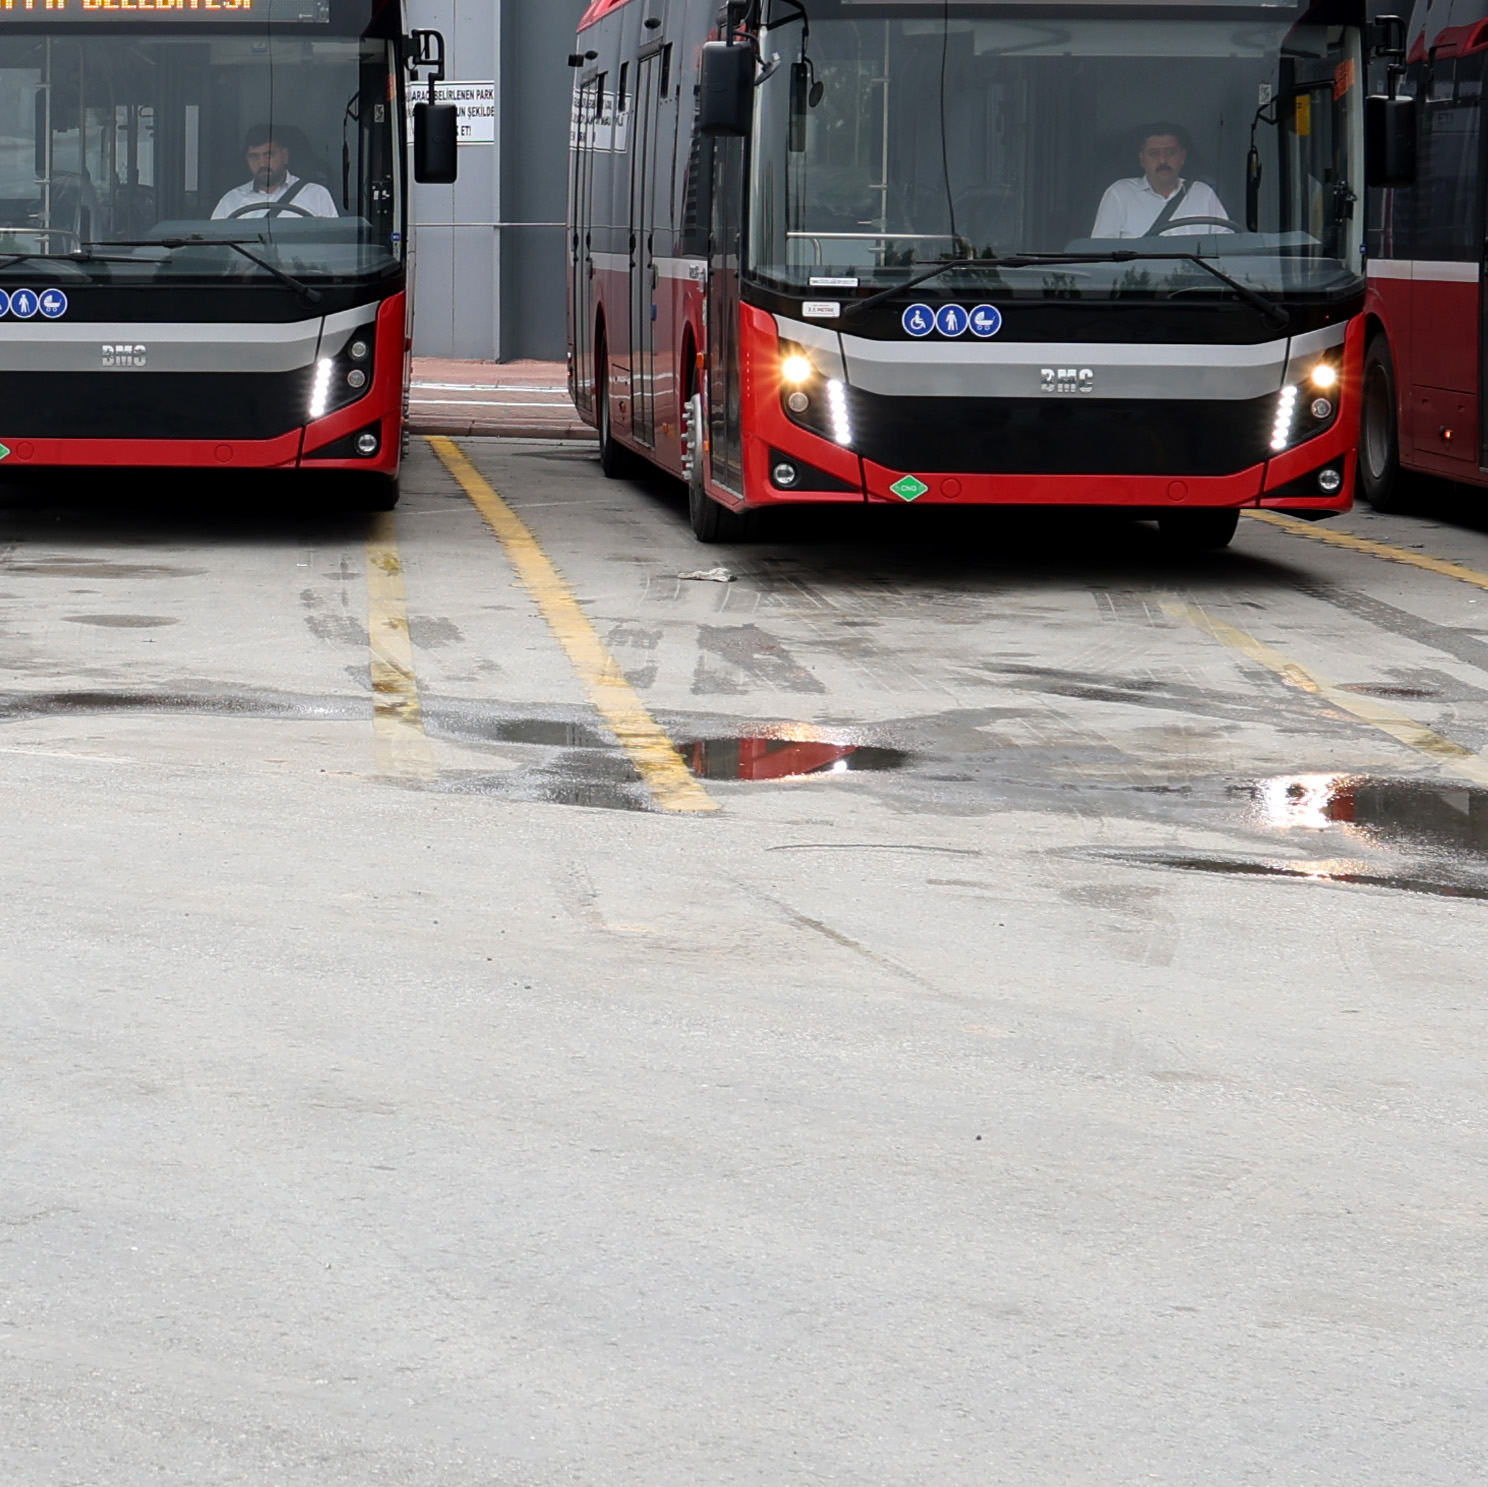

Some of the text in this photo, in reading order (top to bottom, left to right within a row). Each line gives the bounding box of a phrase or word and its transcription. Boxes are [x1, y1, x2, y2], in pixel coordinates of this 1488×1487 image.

[476, 89, 494, 100] PARK
[102, 345, 146, 367] BMC
[1040, 368, 1093, 393] BMC
